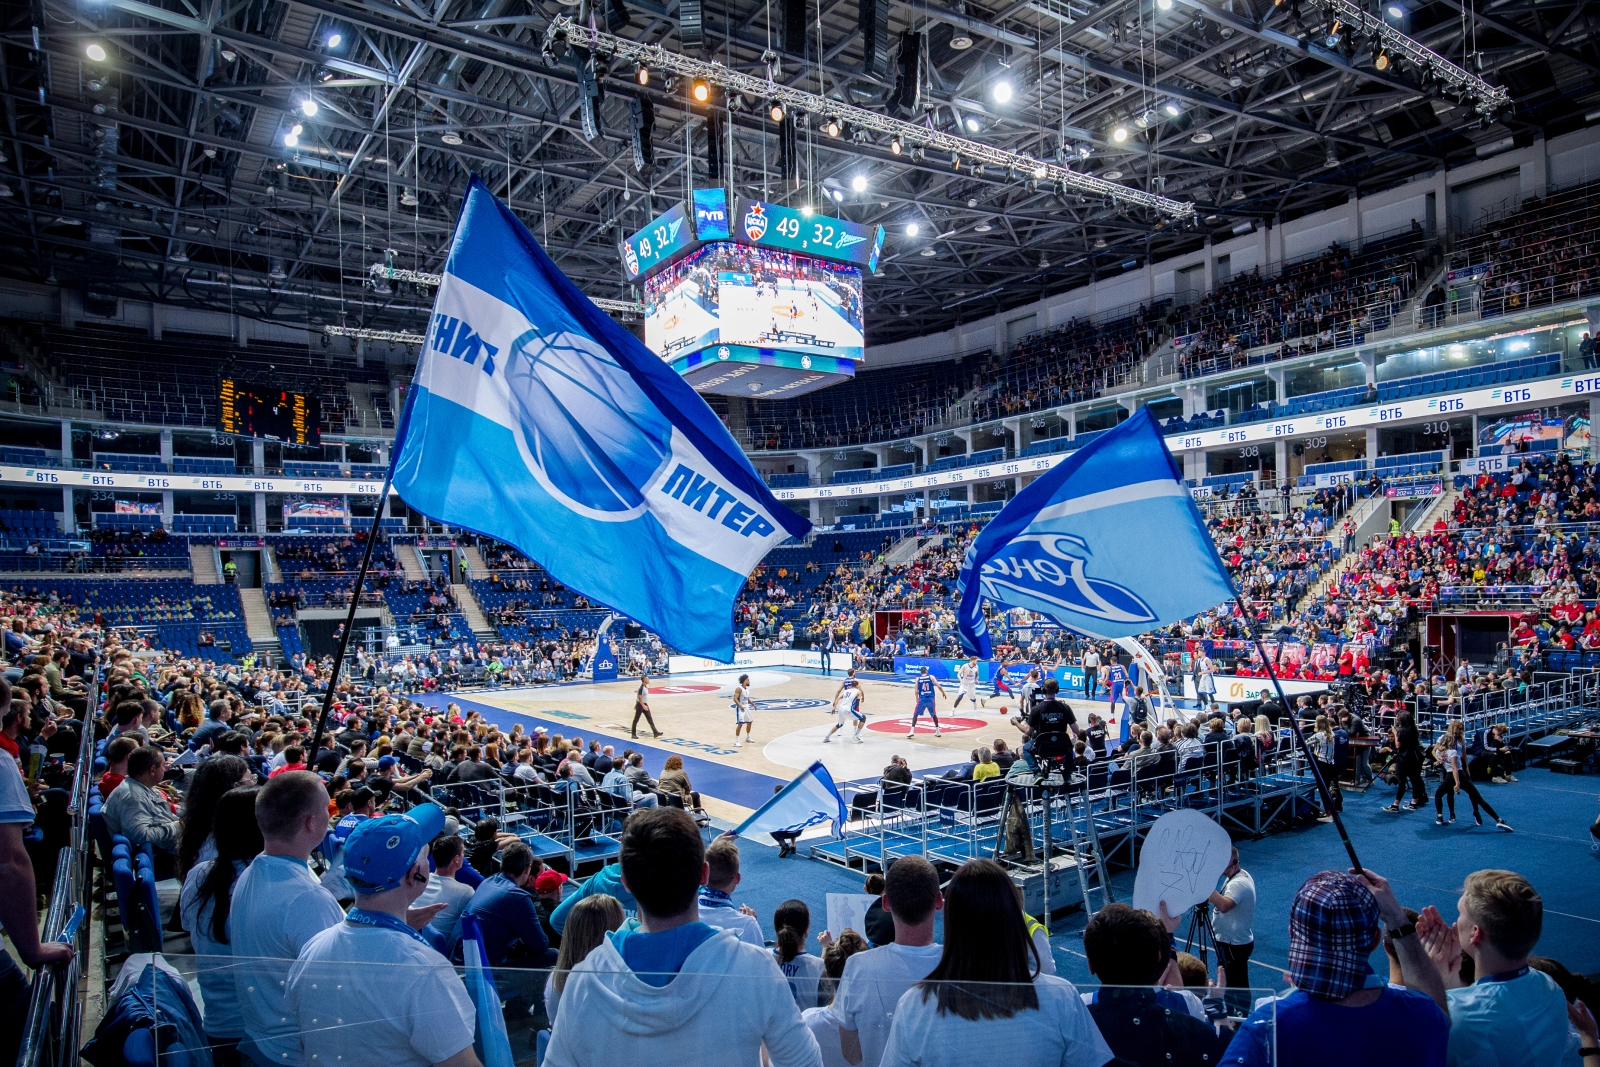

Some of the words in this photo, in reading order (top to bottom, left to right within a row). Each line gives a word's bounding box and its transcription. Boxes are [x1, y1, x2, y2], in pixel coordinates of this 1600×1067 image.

[706, 211, 724, 221] VTB
[776, 217, 800, 238] 49
[654, 225, 670, 249] 32
[812, 224, 835, 246] 32
[639, 237, 652, 258] 49
[802, 240, 808, 248] 3
[1575, 377, 1600, 393] ВТБ
[1504, 388, 1531, 403] ВТБ
[1439, 398, 1464, 412] ВТБ
[1380, 407, 1403, 421] ВТБ
[1325, 415, 1346, 428] ВТБ
[1275, 423, 1294, 435] ВТБ
[1423, 420, 1449, 435] 310
[210, 436, 234, 446] 430
[1228, 430, 1246, 442] ВТБ
[1185, 437, 1202, 448] ВТБ
[1305, 436, 1327, 450] 309
[358, 443, 378, 453] 432
[1239, 446, 1259, 458] 308
[833, 453, 847, 461] 401
[1006, 465, 1019, 473] ВТБ
[1036, 460, 1050, 469] ВТБ
[1478, 458, 1503, 471] ВТБ
[36, 472, 58, 482] ВТБ
[952, 473, 963, 481] ВТБ
[978, 469, 990, 477] ВТБ
[92, 476, 115, 485] ВТБ
[148, 479, 170, 487] ВТБ
[927, 477, 938, 485] ВТБ
[1330, 473, 1349, 485] ВТБ
[202, 480, 223, 489] ВТБ
[254, 482, 274, 490] ВТБ
[304, 483, 323, 491] ВТБ
[358, 484, 377, 492] ВТБ
[993, 481, 1006, 490] 304
[91, 491, 115, 501] 334
[213, 492, 236, 501] 335
[285, 494, 305, 503] 336
[361, 494, 381, 503] 33
[1193, 488, 1209, 499] ВТБ
[660, 463, 776, 537] ПИТЕР
[835, 499, 849, 507] 301
[1072, 675, 1085, 687] ВТ
